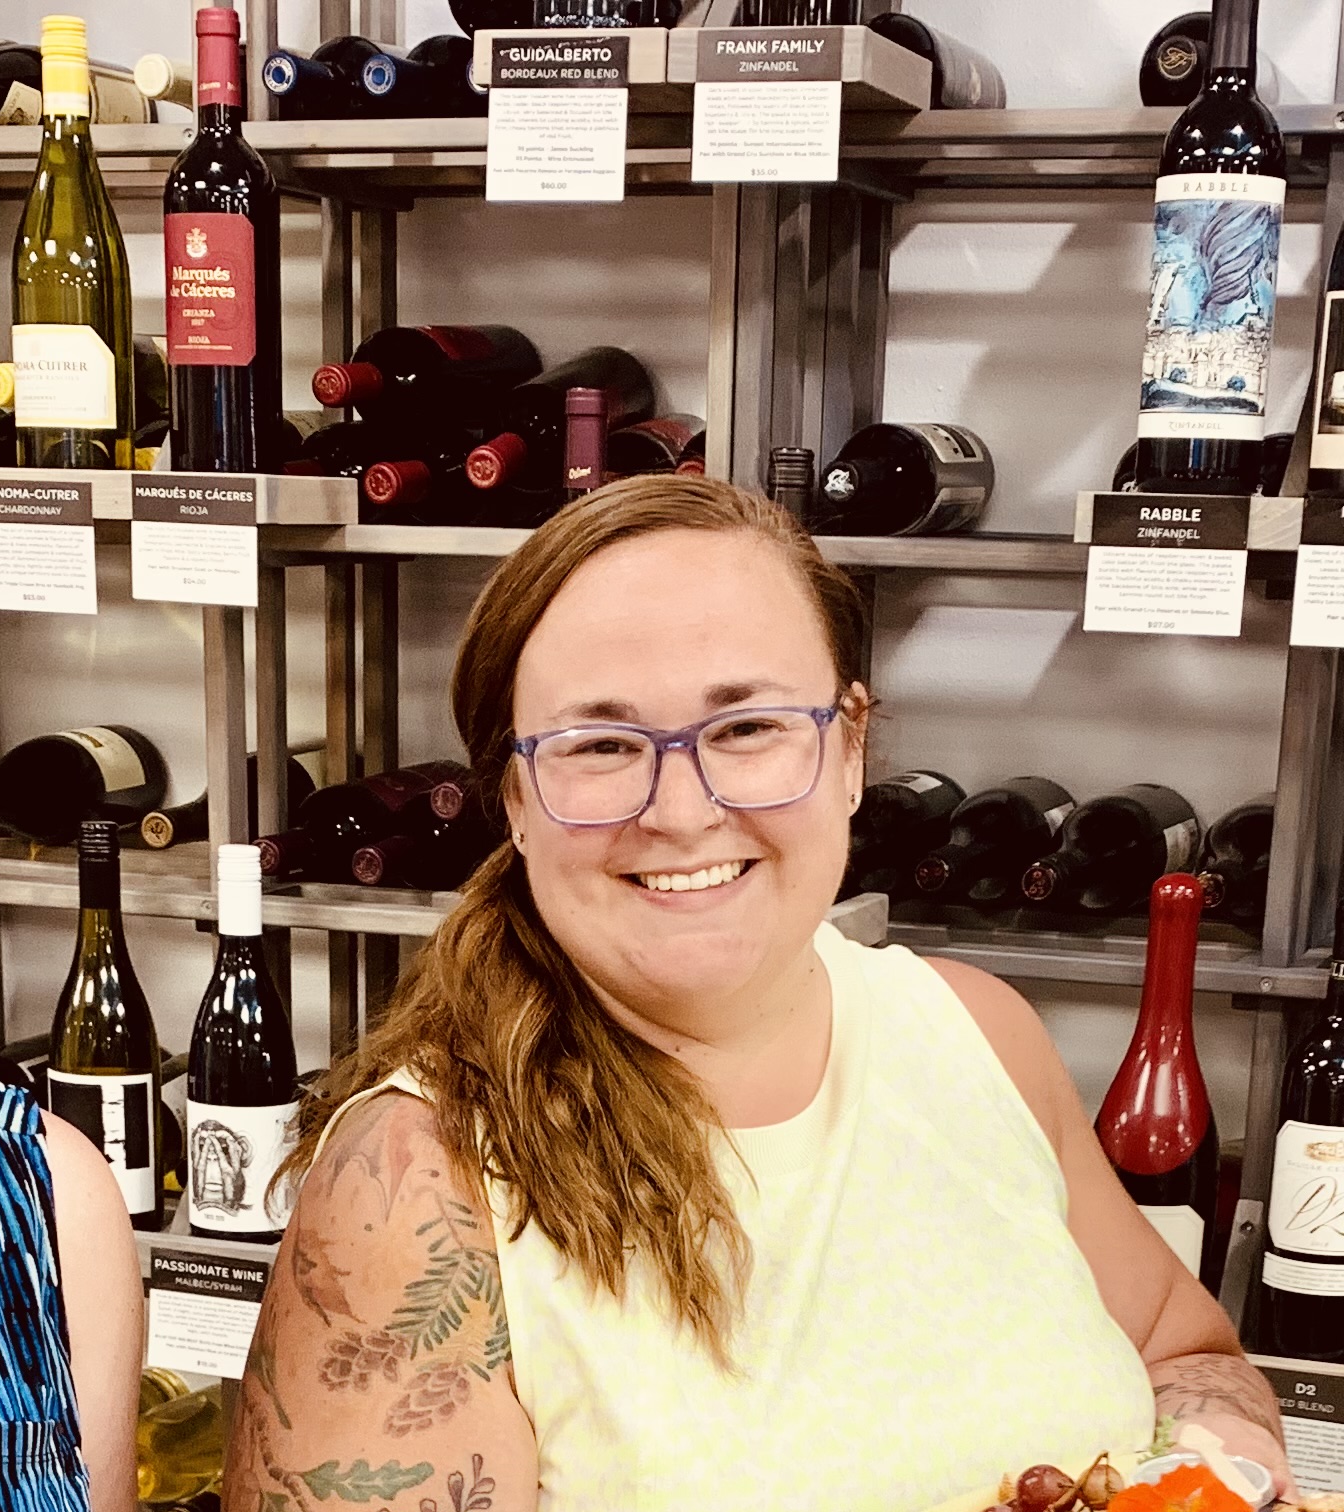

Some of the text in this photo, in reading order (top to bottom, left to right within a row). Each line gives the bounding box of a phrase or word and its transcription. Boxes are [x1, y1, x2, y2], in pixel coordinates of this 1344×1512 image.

[716, 40, 824, 54] FRANK FAMILY
[510, 48, 611, 62] GUIDALBERTO
[739, 61, 799, 72] ZINFANDEL
[501, 69, 619, 79] BORDEAUX RED BLEND
[1183, 182, 1249, 193] RABBLE
[173, 265, 230, 284] Marqués
[181, 283, 236, 298] Cáceres
[135, 484, 254, 502] MARQUÉS DE CÁCERES
[179, 504, 209, 516] RIOJA
[1140, 507, 1202, 522] RABBLE
[1137, 527, 1201, 539] ZINFANDEL
[154, 1258, 264, 1282] PASSIONATE WINE
[175, 1276, 243, 1293] MALBEC/SYRAH
[1295, 1383, 1316, 1396] D2
[1298, 1401, 1335, 1413] BLEND
